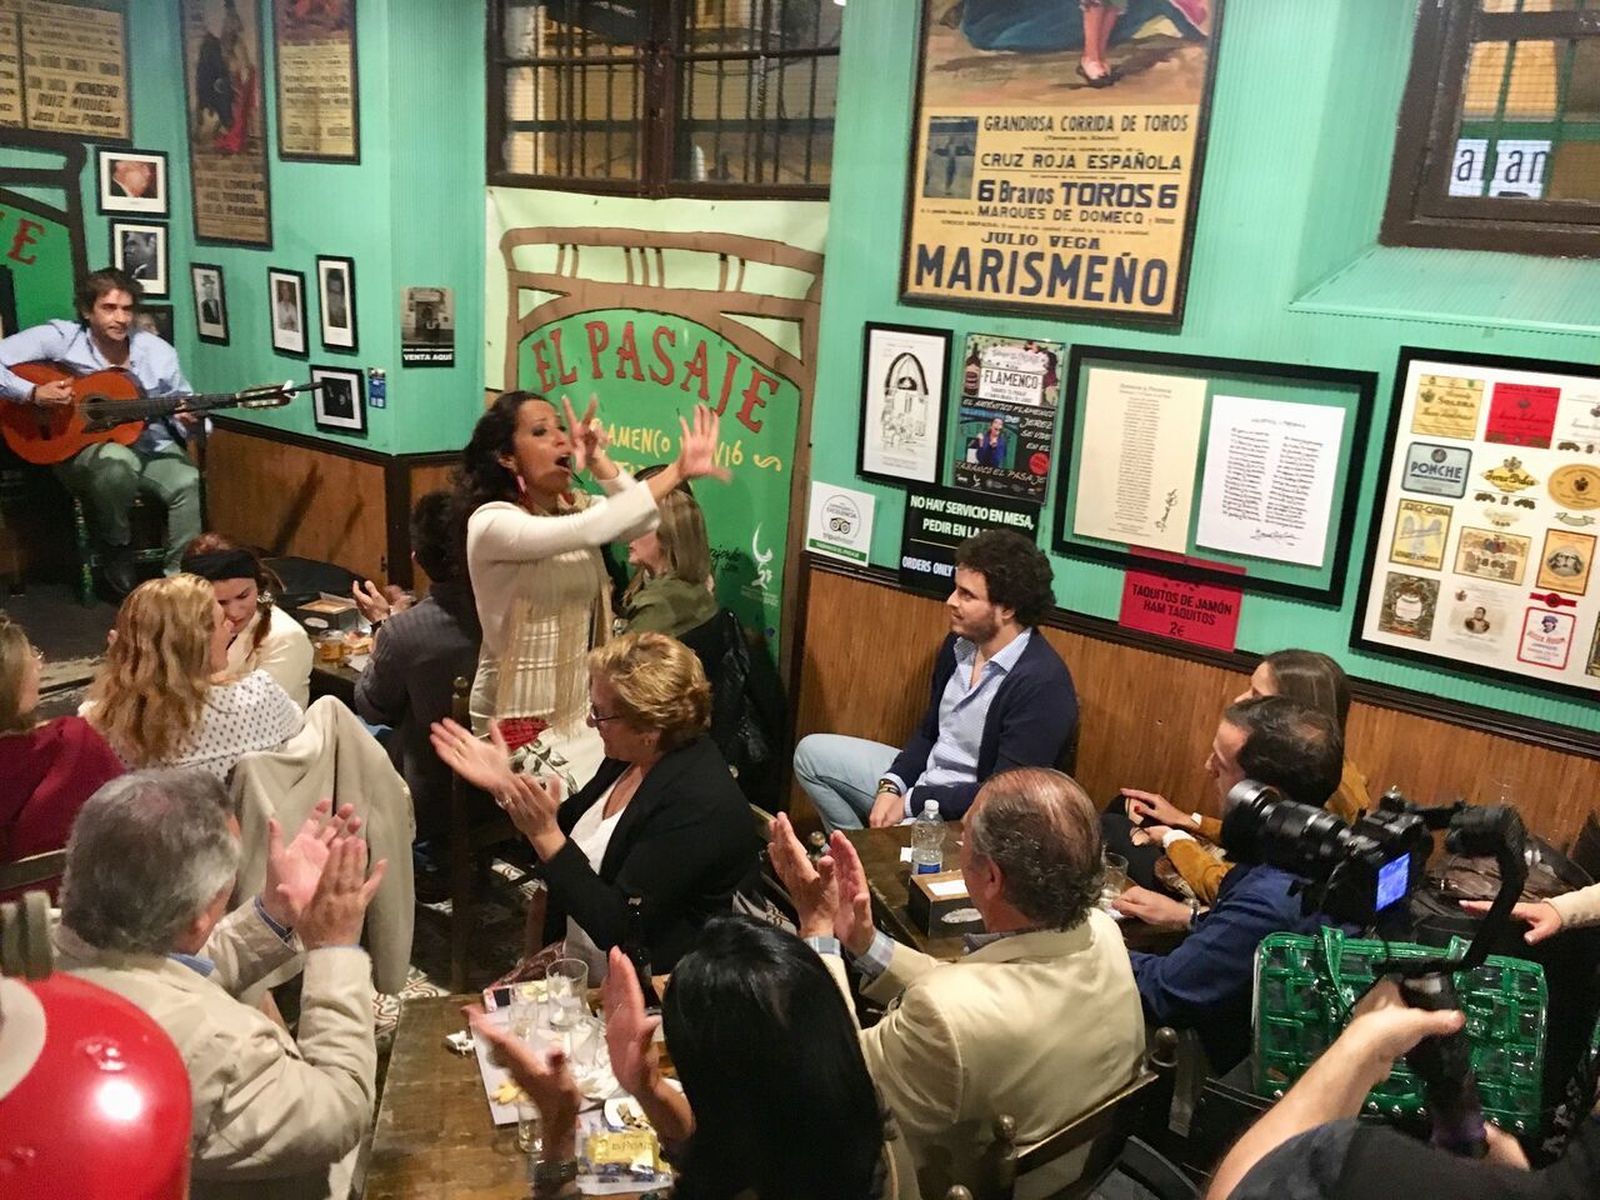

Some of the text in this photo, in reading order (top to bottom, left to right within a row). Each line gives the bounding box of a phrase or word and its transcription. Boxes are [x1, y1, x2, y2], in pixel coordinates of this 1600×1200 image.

[984, 115, 1188, 132] GRANDIOSA CORRIDA DE TOROS
[981, 152, 1182, 170] CRUZ ROJA ESPAÑOLA
[977, 180, 1180, 209] 6 Bravos TOROS 6
[977, 206, 1046, 221] MARQUES
[1053, 208, 1072, 221] DE
[1079, 209, 1144, 224] DOMECQ
[981, 231, 1100, 249] JULIO VEGA
[914, 243, 1169, 306] MARISMEÑO
[531, 320, 781, 434] EL PASAJE
[984, 369, 1039, 389] FLAMENCO
[1411, 462, 1462, 478] PONCHE
[910, 495, 1035, 530] NO HAY SERVICIO EN MESA,
[923, 518, 952, 535] PEDIR
[952, 524, 967, 537] EN
[902, 555, 954, 577] ORDERS ONLY
[1132, 584, 1232, 615] TAQUITOS DE JAMÓN
[1143, 599, 1216, 626] HAM TAQUITOS
[1169, 622, 1185, 637] 2€
